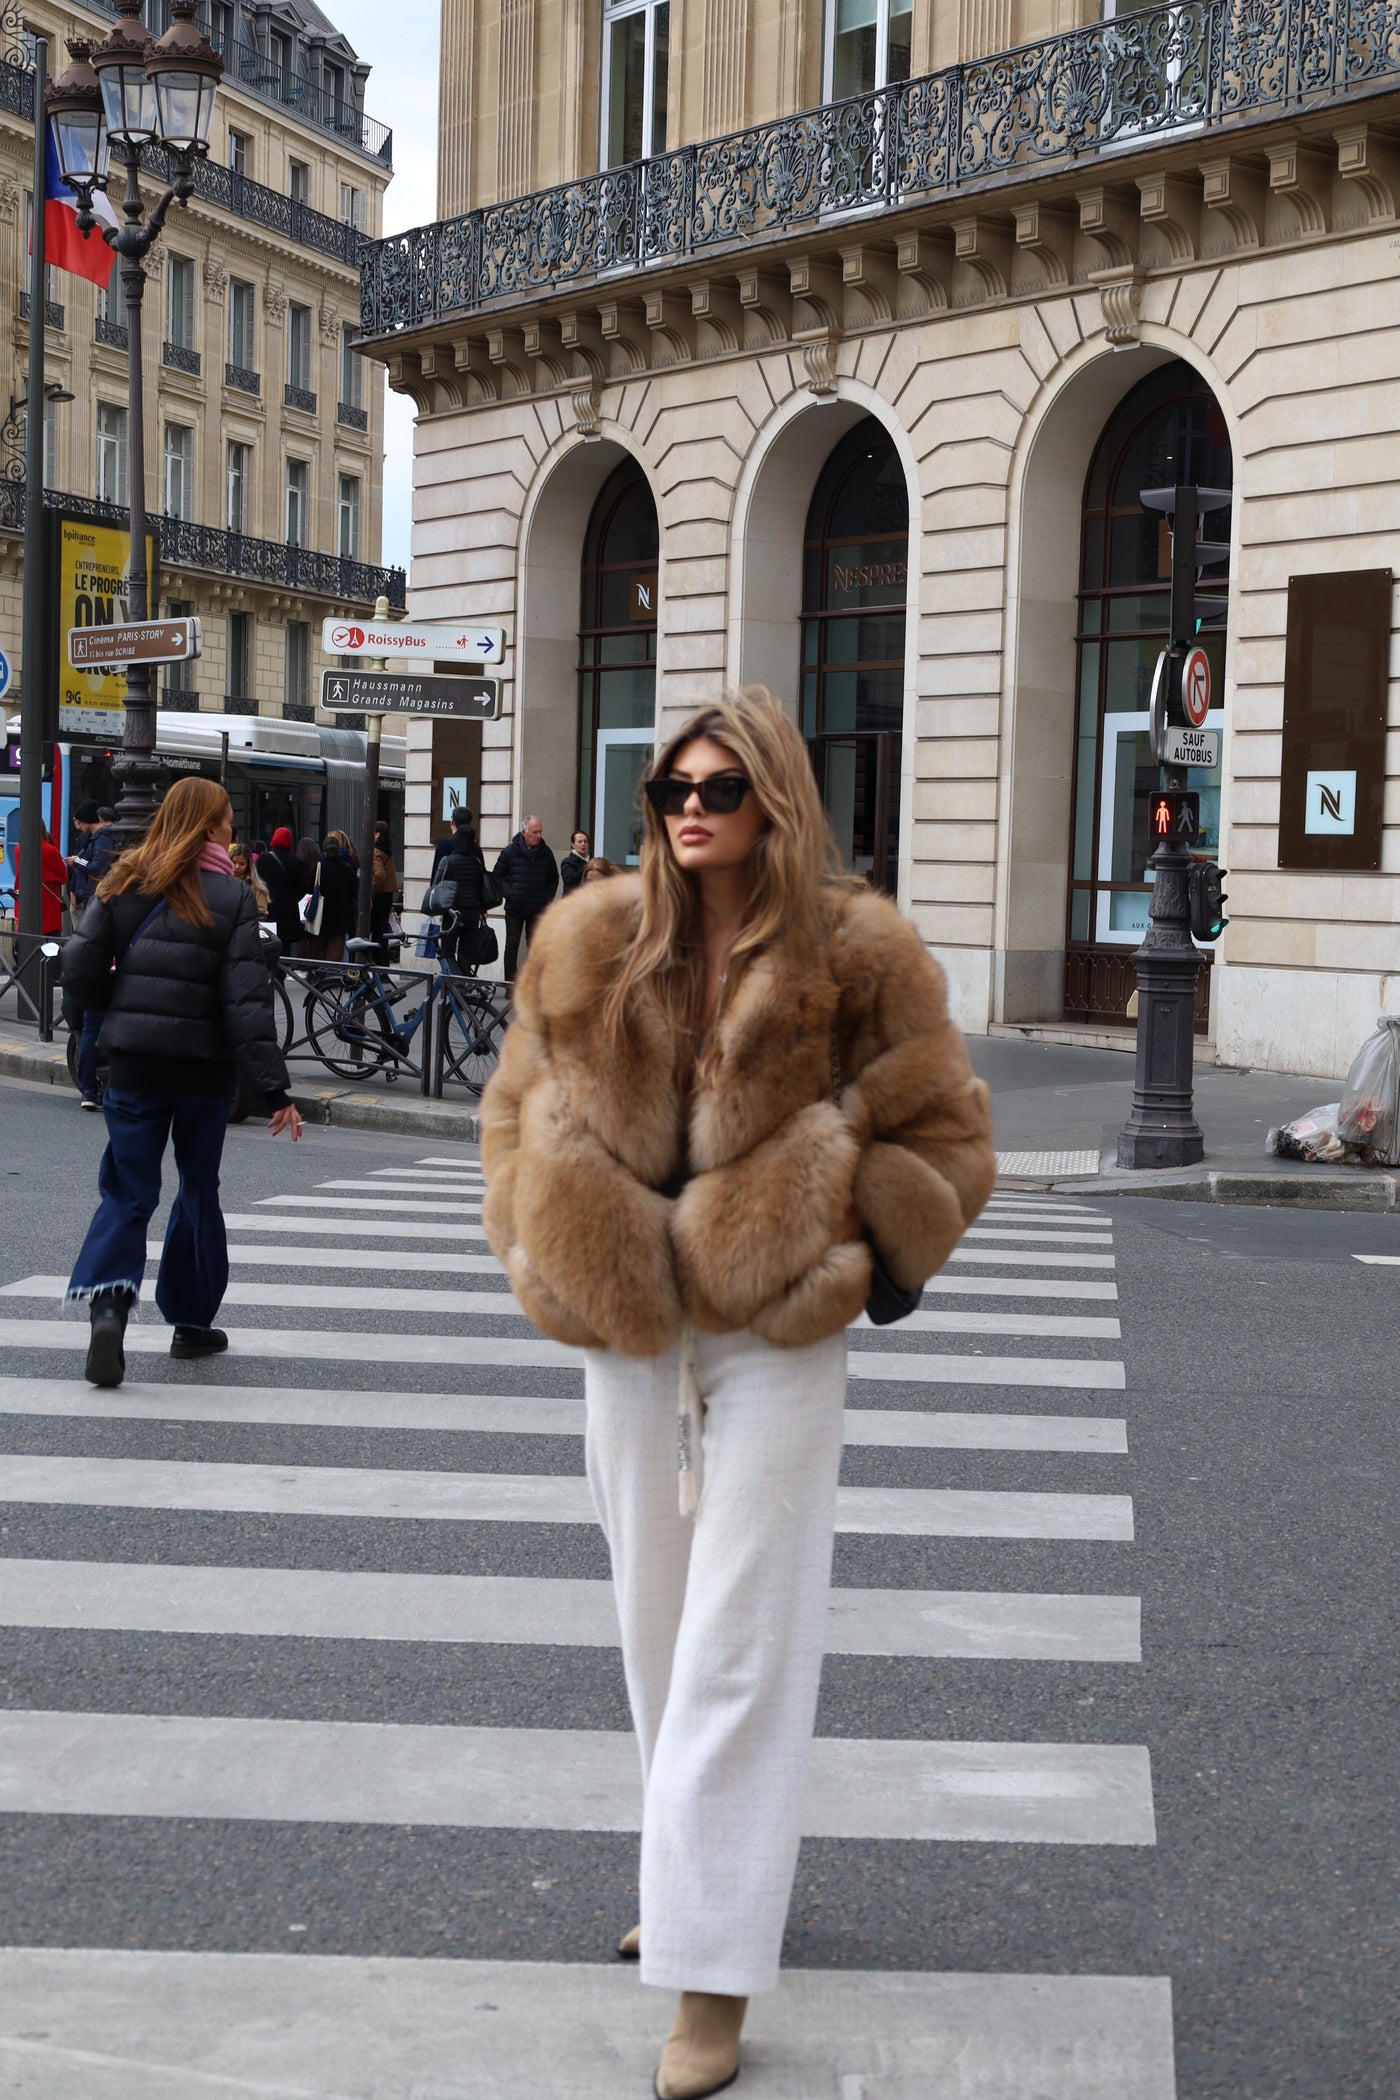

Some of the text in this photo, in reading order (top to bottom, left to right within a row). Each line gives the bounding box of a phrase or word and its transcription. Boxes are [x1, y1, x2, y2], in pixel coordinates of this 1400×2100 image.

[74, 573, 130, 597] LE PROGRÈ
[89, 629, 165, 646] Cinéma PARIS-STORY
[368, 633, 427, 648] RoissyBus
[114, 646, 136, 657] SCRIBE
[352, 679, 422, 692] Haussmann
[352, 694, 454, 710] Grands Magasins
[1182, 732, 1205, 747] SAUF
[1174, 747, 1213, 763] AUTOBUS
[1314, 783, 1348, 822] N
